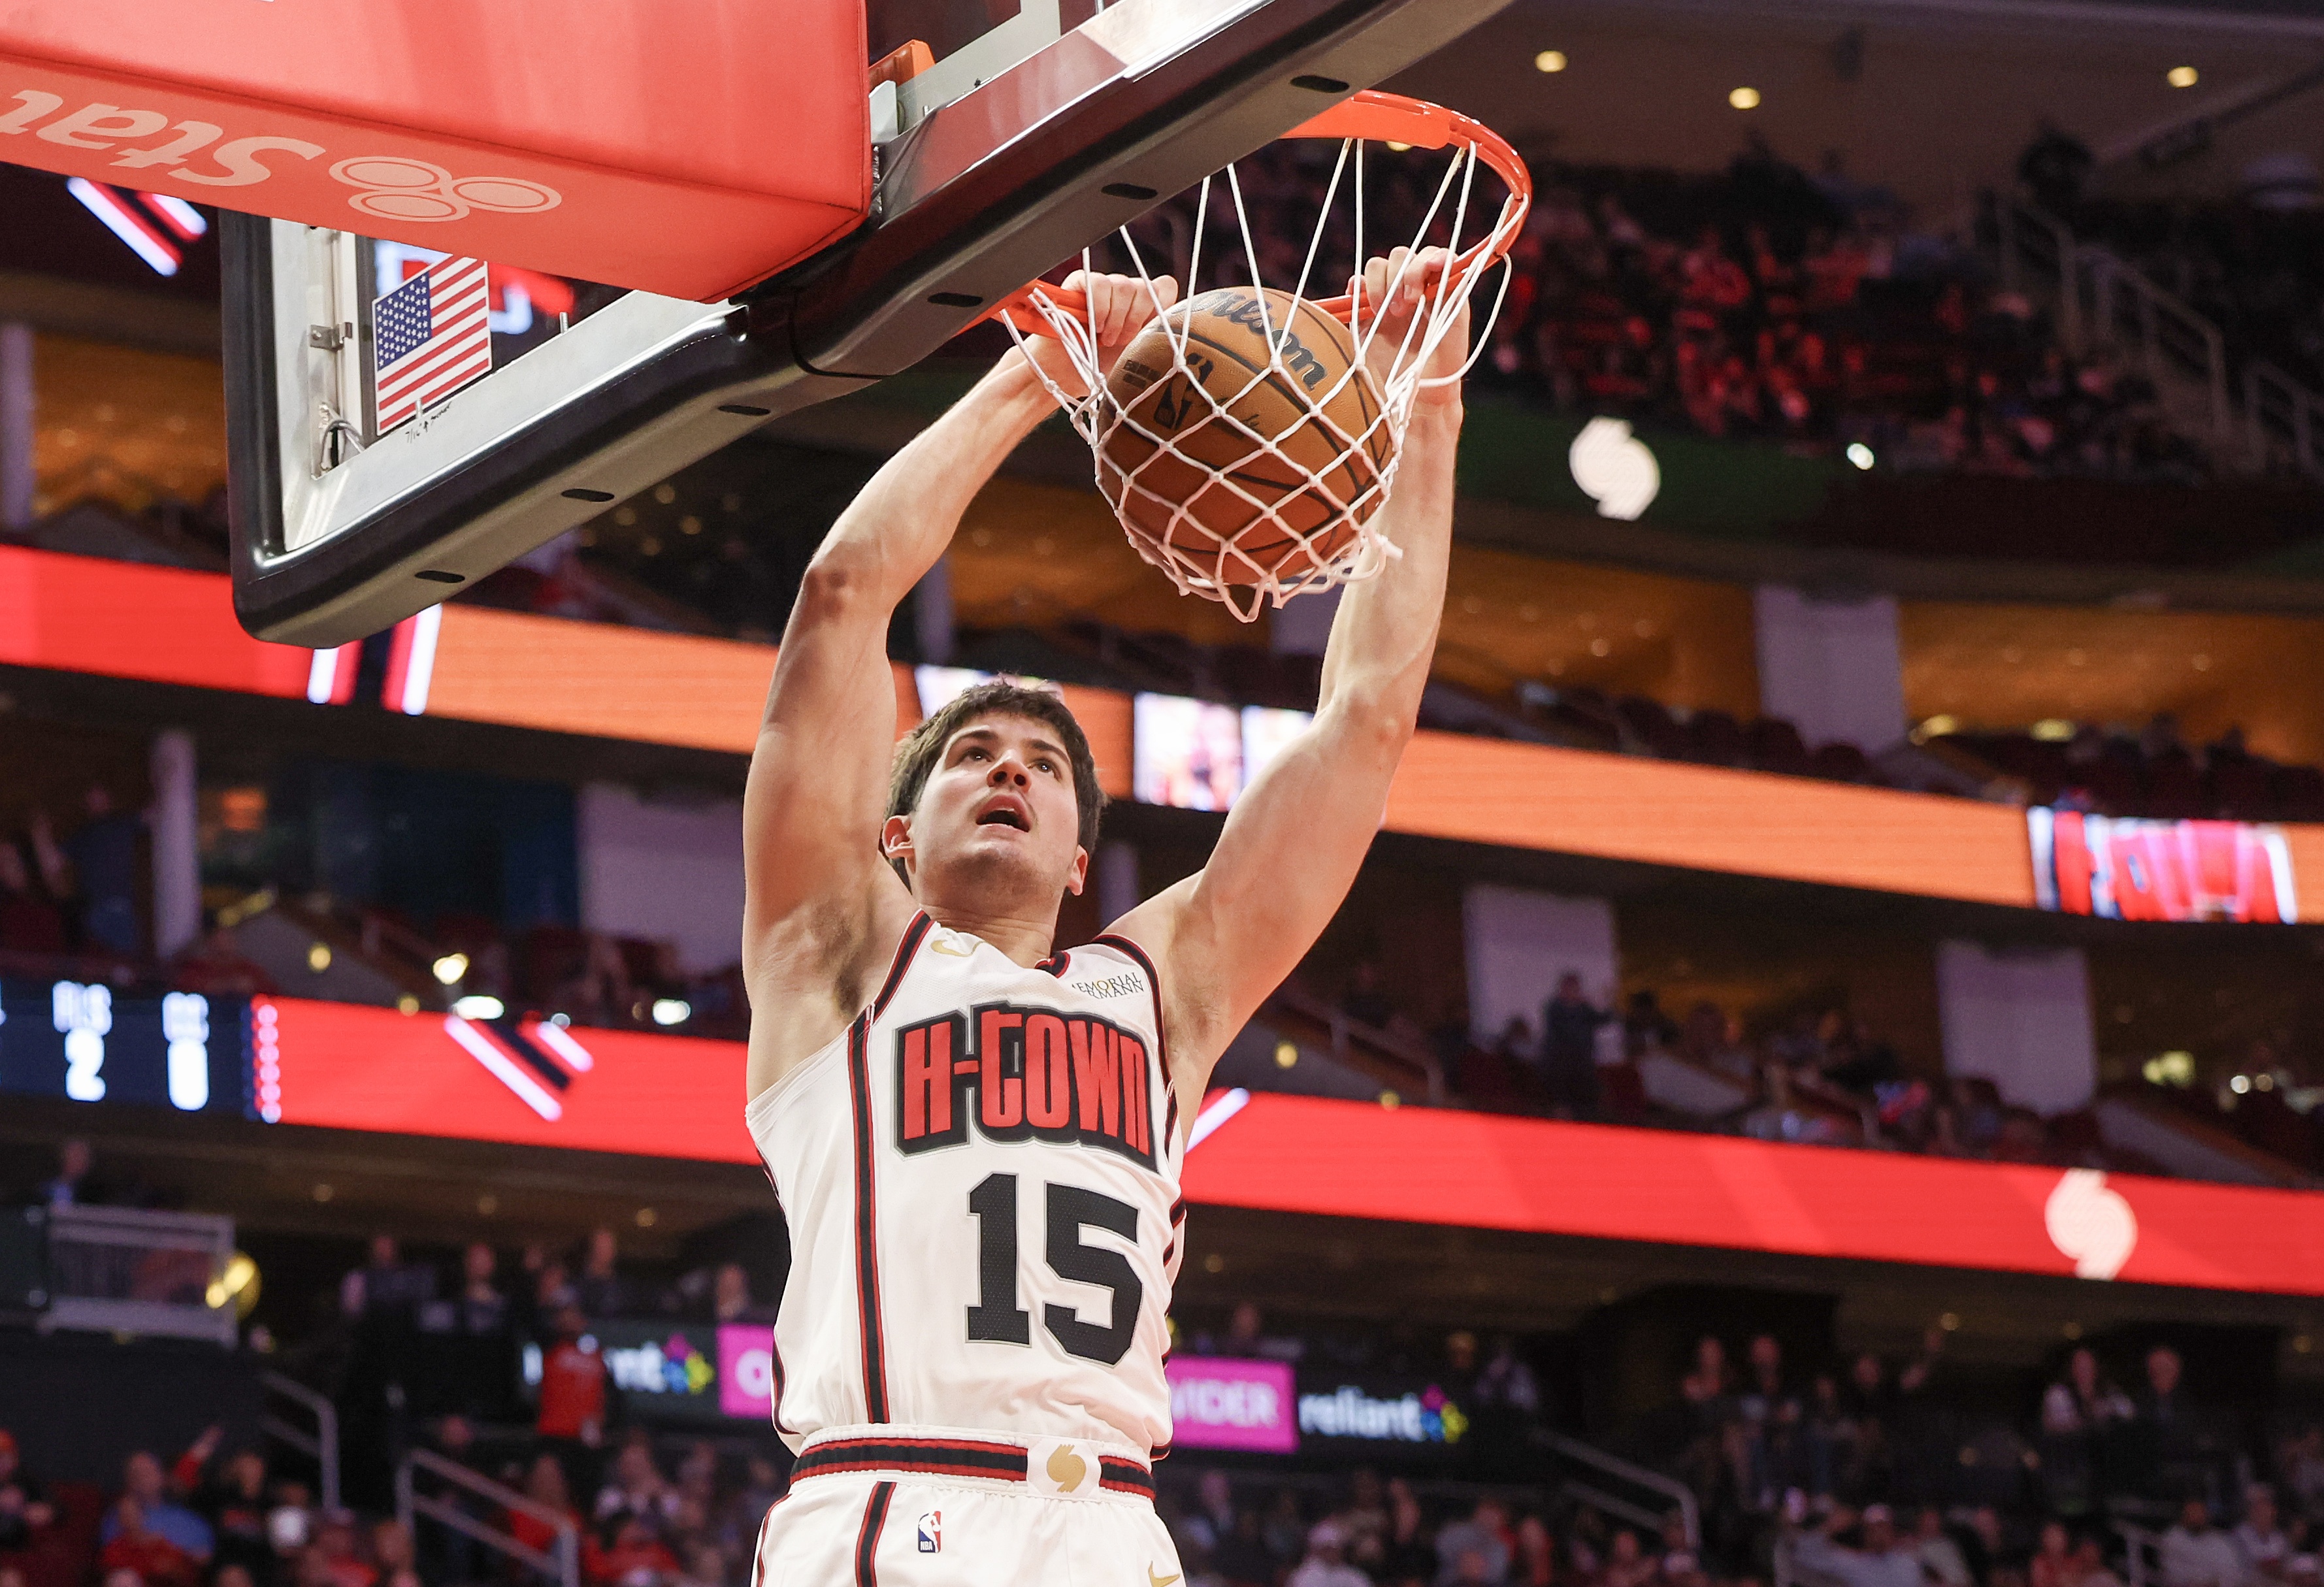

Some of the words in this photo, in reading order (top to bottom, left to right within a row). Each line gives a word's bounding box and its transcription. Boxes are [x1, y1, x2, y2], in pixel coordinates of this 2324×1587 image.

[1072, 972, 1141, 992] EMORIAL
[1087, 981, 1145, 1000] RMANN
[895, 1001, 1160, 1176] H-TOWN
[965, 1171, 1144, 1368] 15
[1299, 1386, 1423, 1442] reliant
[920, 1541, 933, 1551] NBA
